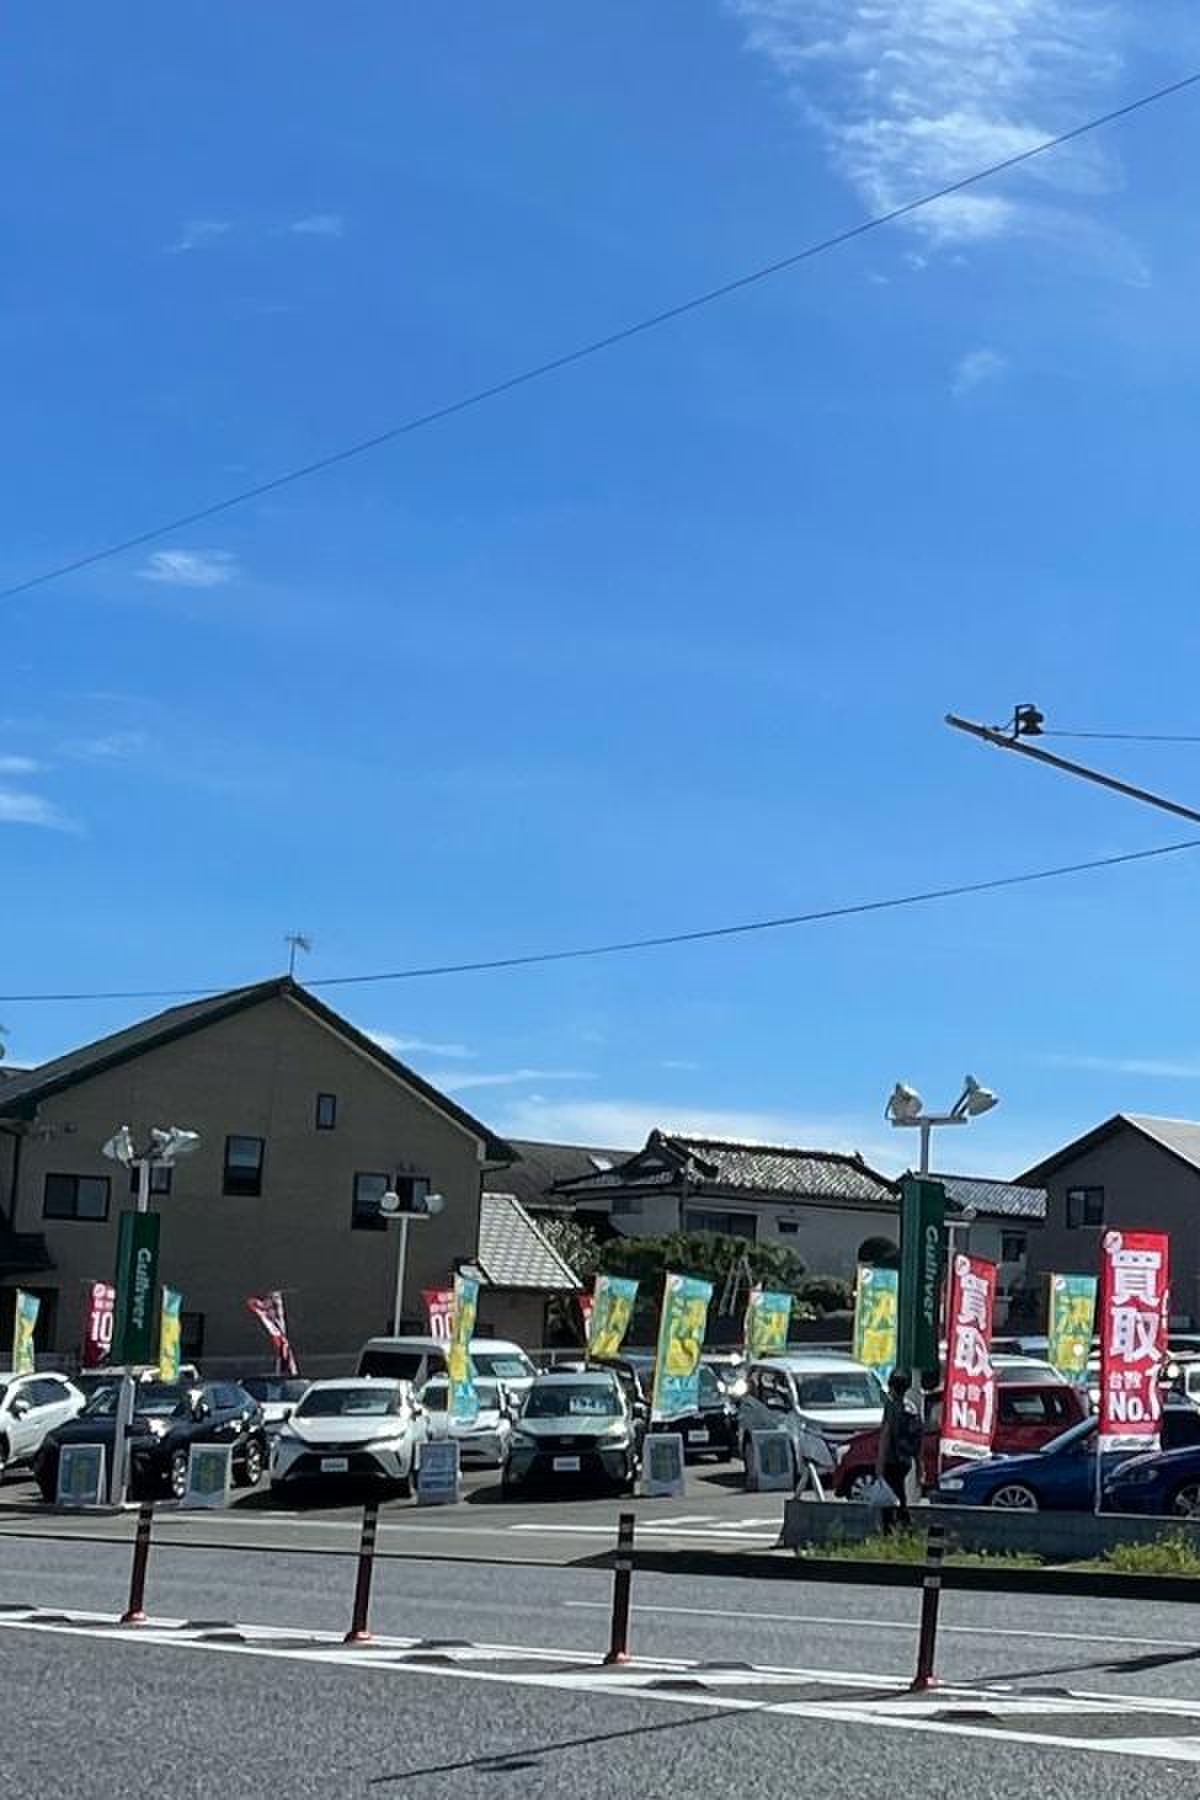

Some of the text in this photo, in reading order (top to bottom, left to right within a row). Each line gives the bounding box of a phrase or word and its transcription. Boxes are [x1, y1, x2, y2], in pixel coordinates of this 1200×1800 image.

[132, 1247, 152, 1329] Gulliver
[924, 1225, 939, 1325] Gulliver
[955, 1273, 992, 1378] 買取
[1110, 1250, 1162, 1363] 買取
